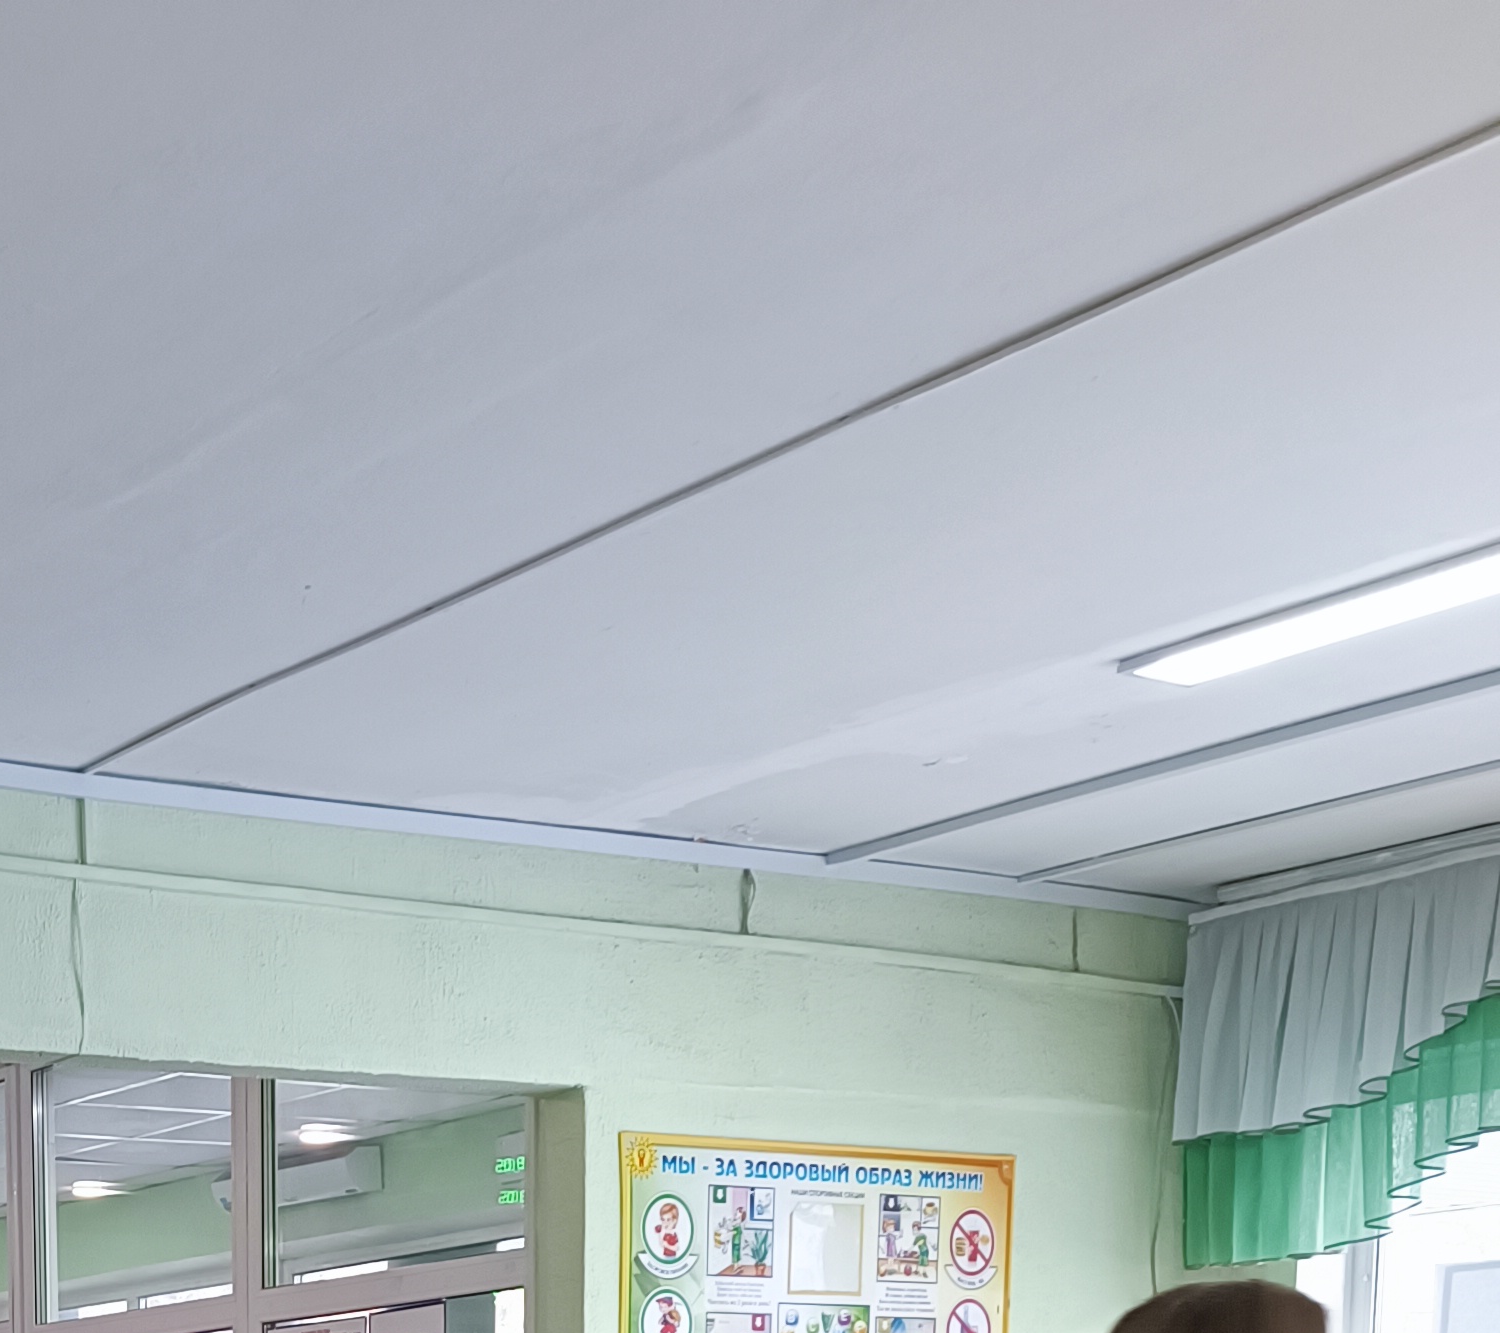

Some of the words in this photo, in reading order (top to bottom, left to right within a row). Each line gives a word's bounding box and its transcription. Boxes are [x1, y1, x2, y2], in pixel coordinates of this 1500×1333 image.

[662, 1155, 695, 1174] МЫ
[715, 1157, 737, 1177] ЗА
[744, 1159, 849, 1183] ЗДОРОВЫЙ
[855, 1166, 912, 1187] ОБРАЗ
[918, 1170, 983, 1191] ЖИЗНИ!
